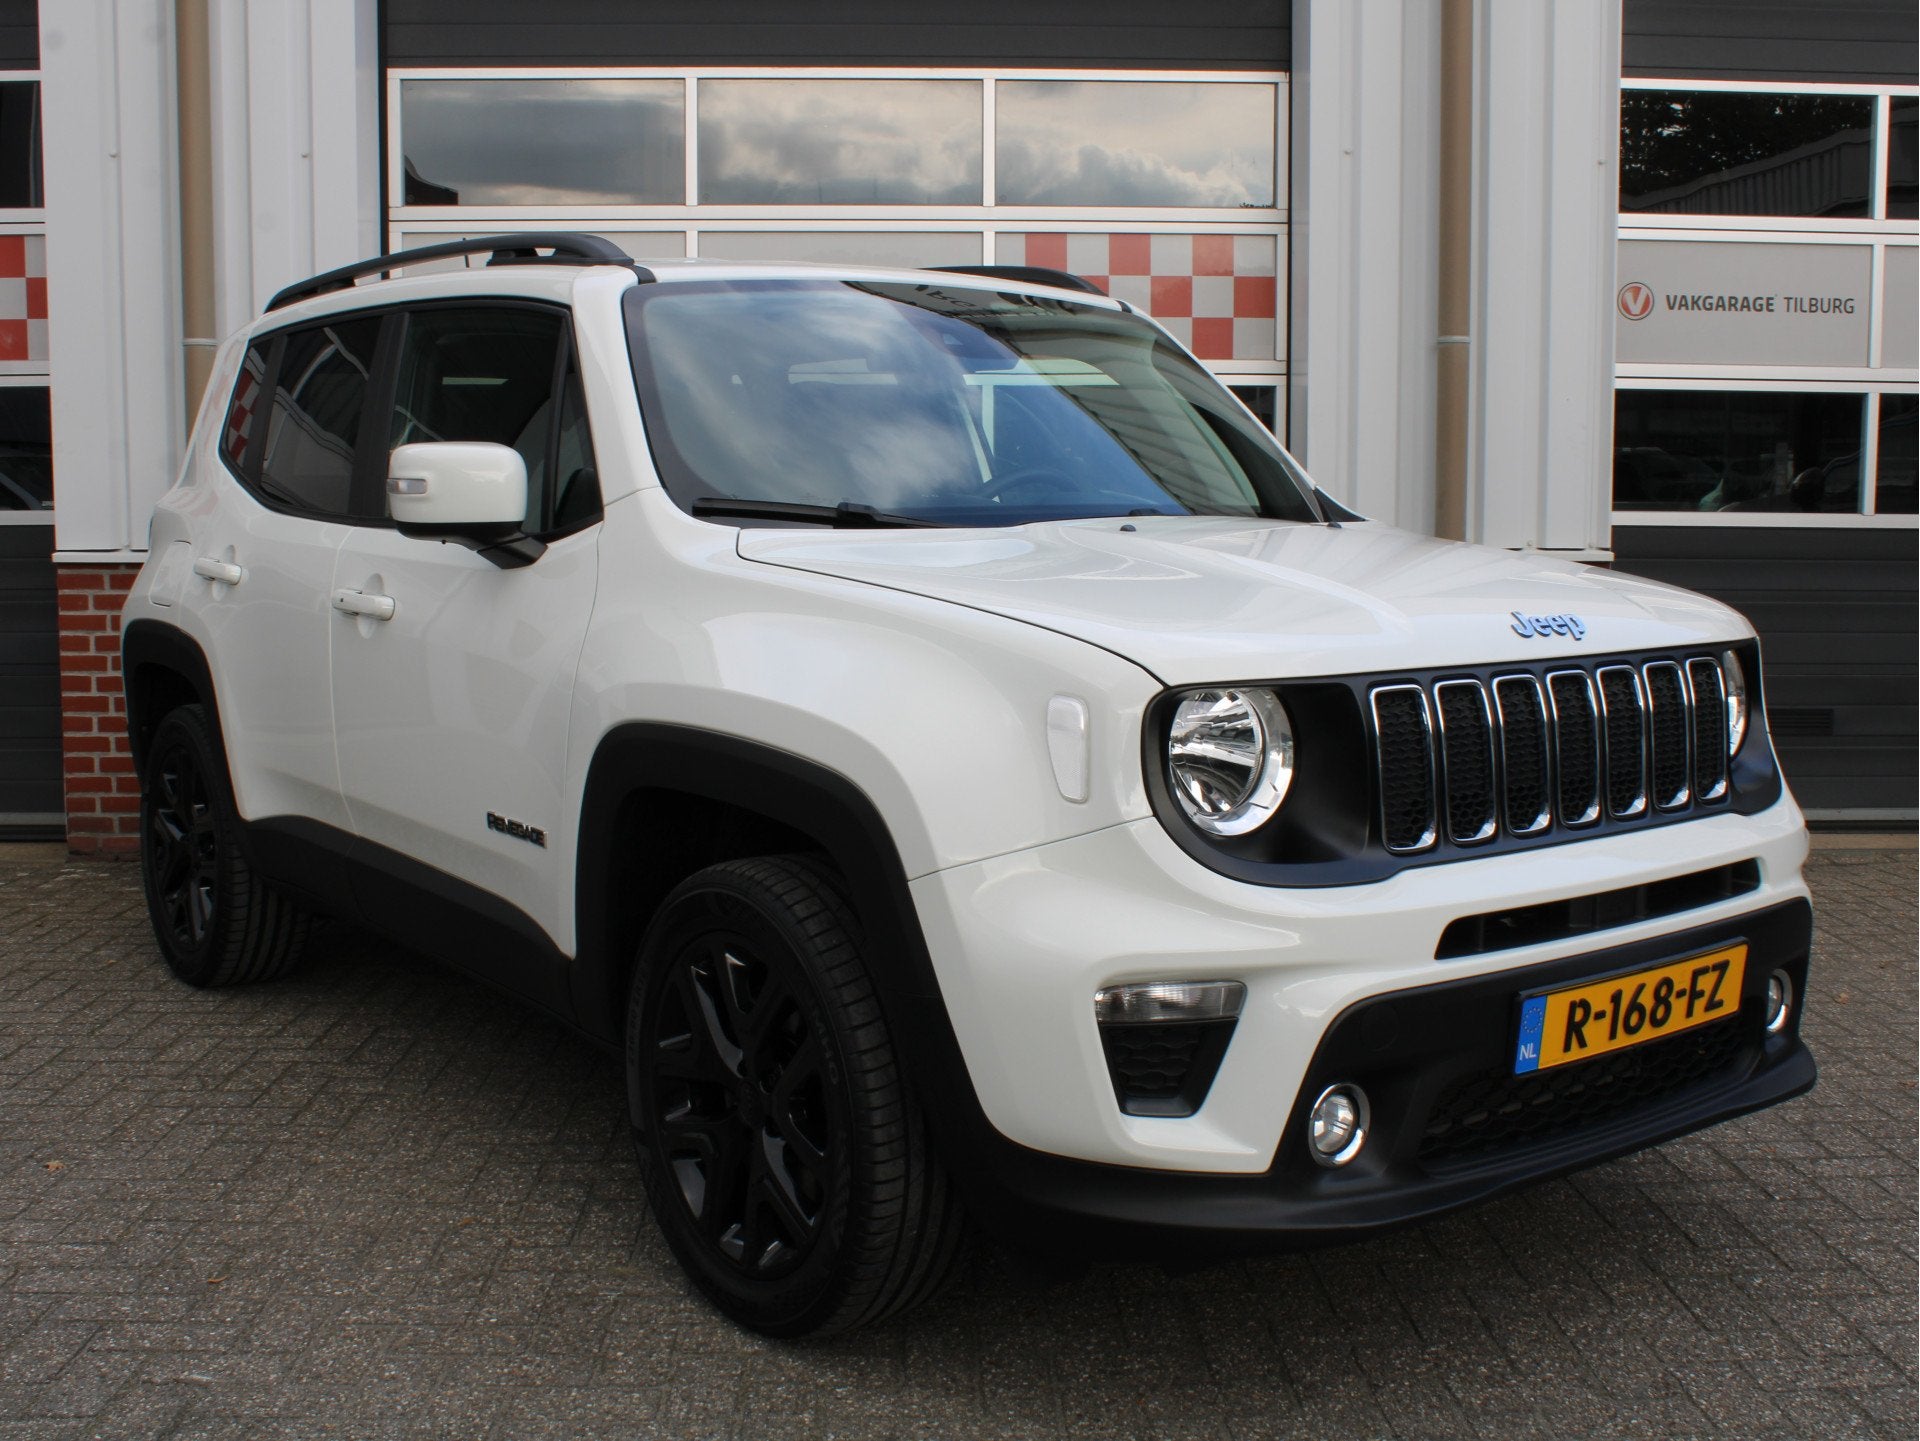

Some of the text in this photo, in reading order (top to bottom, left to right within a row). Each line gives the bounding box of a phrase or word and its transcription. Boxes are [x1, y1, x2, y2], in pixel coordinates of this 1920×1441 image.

[1666, 294, 1776, 313] VAKGARAGE
[1784, 296, 1855, 314] TILBURG
[1510, 611, 1585, 641] Jeep
[1563, 958, 1731, 1053] R-168-FZ
[1519, 1043, 1538, 1060] NL
